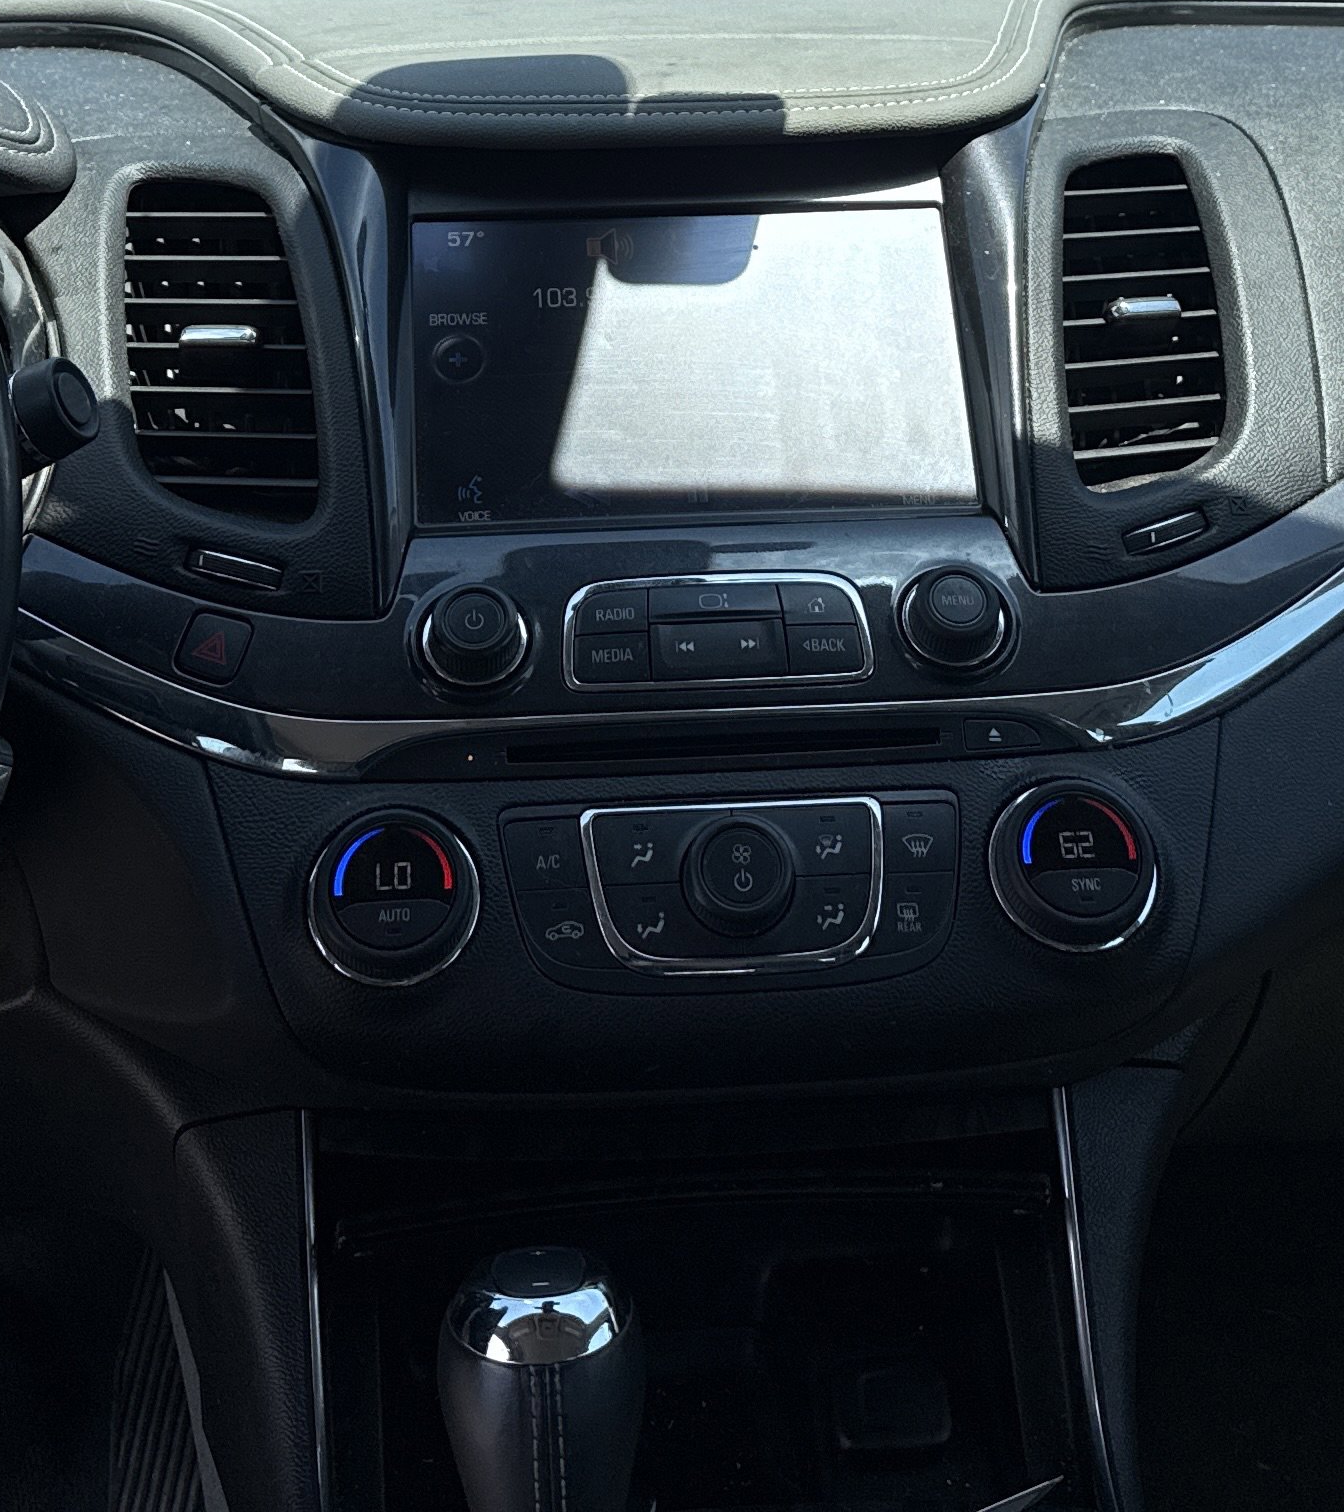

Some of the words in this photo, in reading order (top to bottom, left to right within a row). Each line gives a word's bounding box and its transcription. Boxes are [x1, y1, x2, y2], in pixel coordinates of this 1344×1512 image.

[429, 312, 489, 327] BROWSE
[458, 510, 492, 522] VOICE
[941, 594, 975, 606] MENU
[595, 607, 636, 622] RADIO
[811, 637, 846, 653] BACK
[591, 648, 634, 664] MEDIA
[1058, 831, 1096, 859] 62
[536, 854, 561, 871] A/C
[1071, 877, 1102, 892] SYNC
[378, 907, 411, 923] AUTO
[896, 921, 922, 932] REAR
